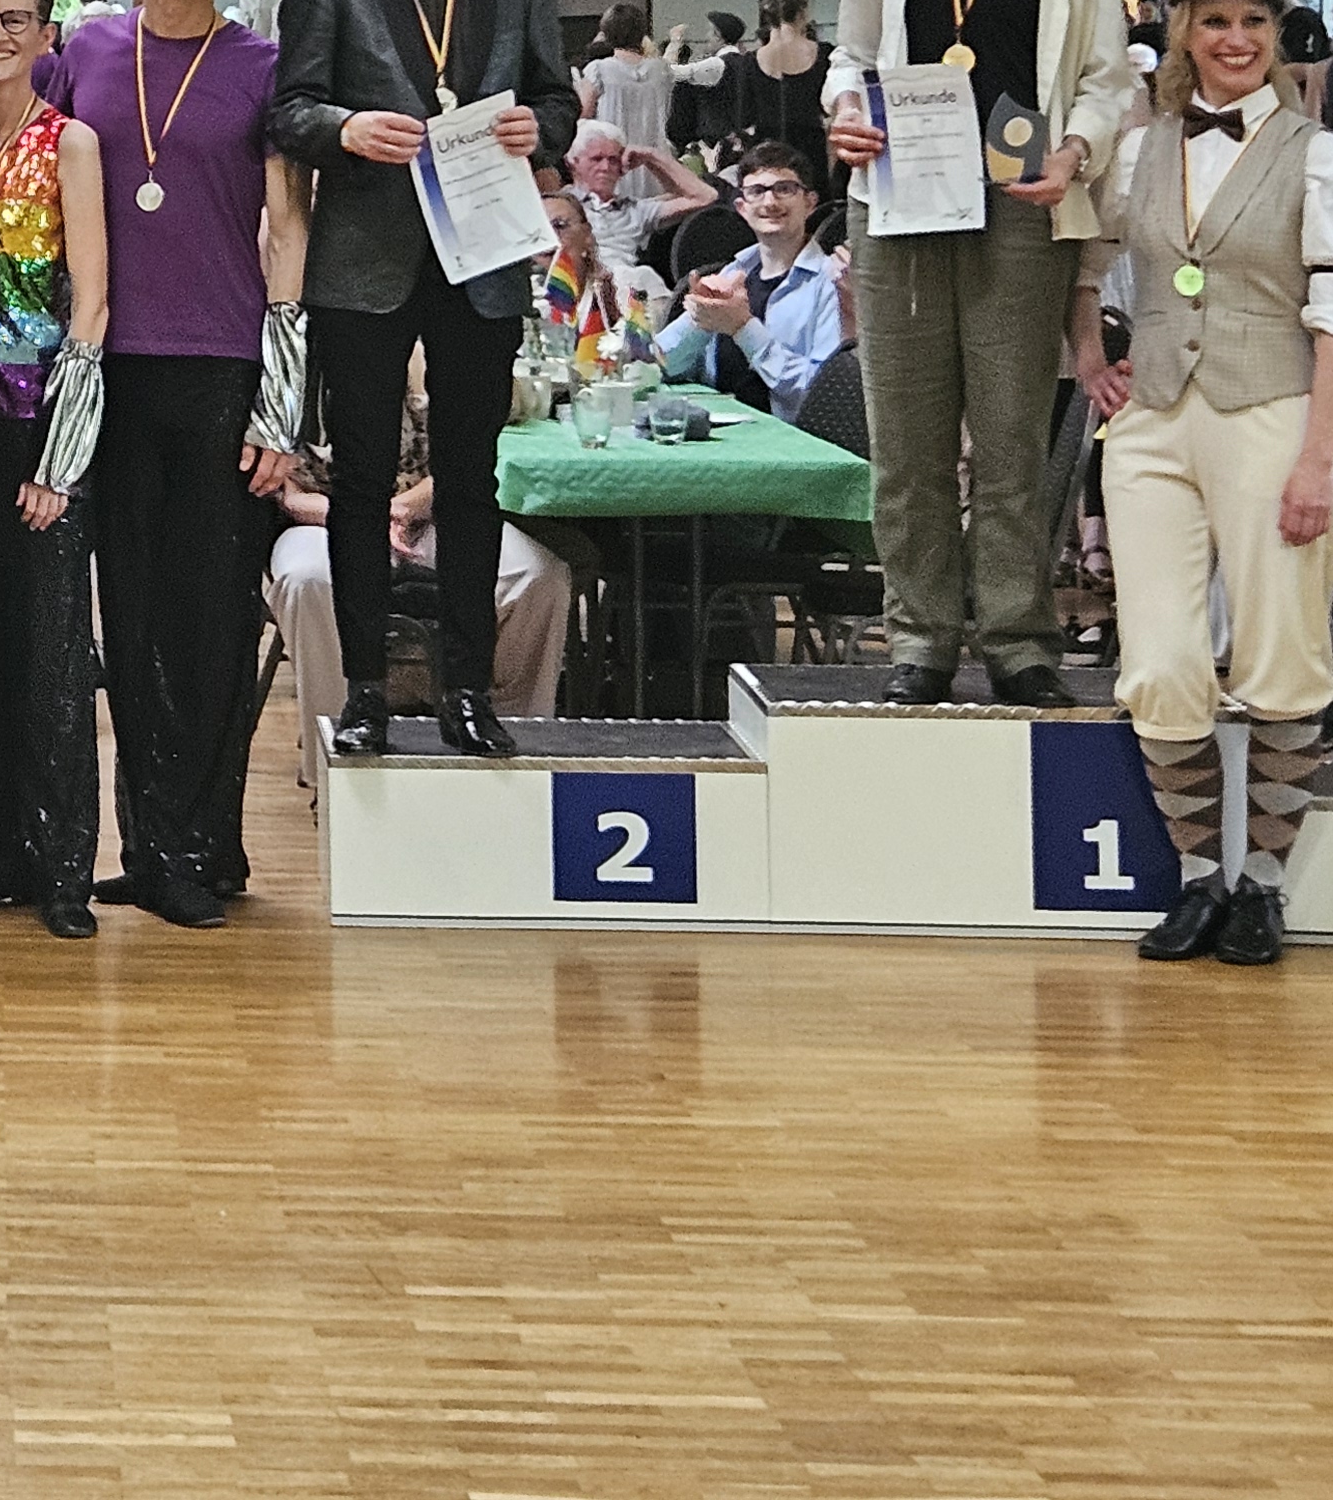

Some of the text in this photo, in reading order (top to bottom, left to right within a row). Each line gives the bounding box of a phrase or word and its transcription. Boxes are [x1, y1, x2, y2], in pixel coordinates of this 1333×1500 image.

[888, 88, 958, 107] Urkunde
[436, 124, 494, 153] Urkund
[595, 810, 655, 883] 2
[1082, 818, 1136, 891] 1
